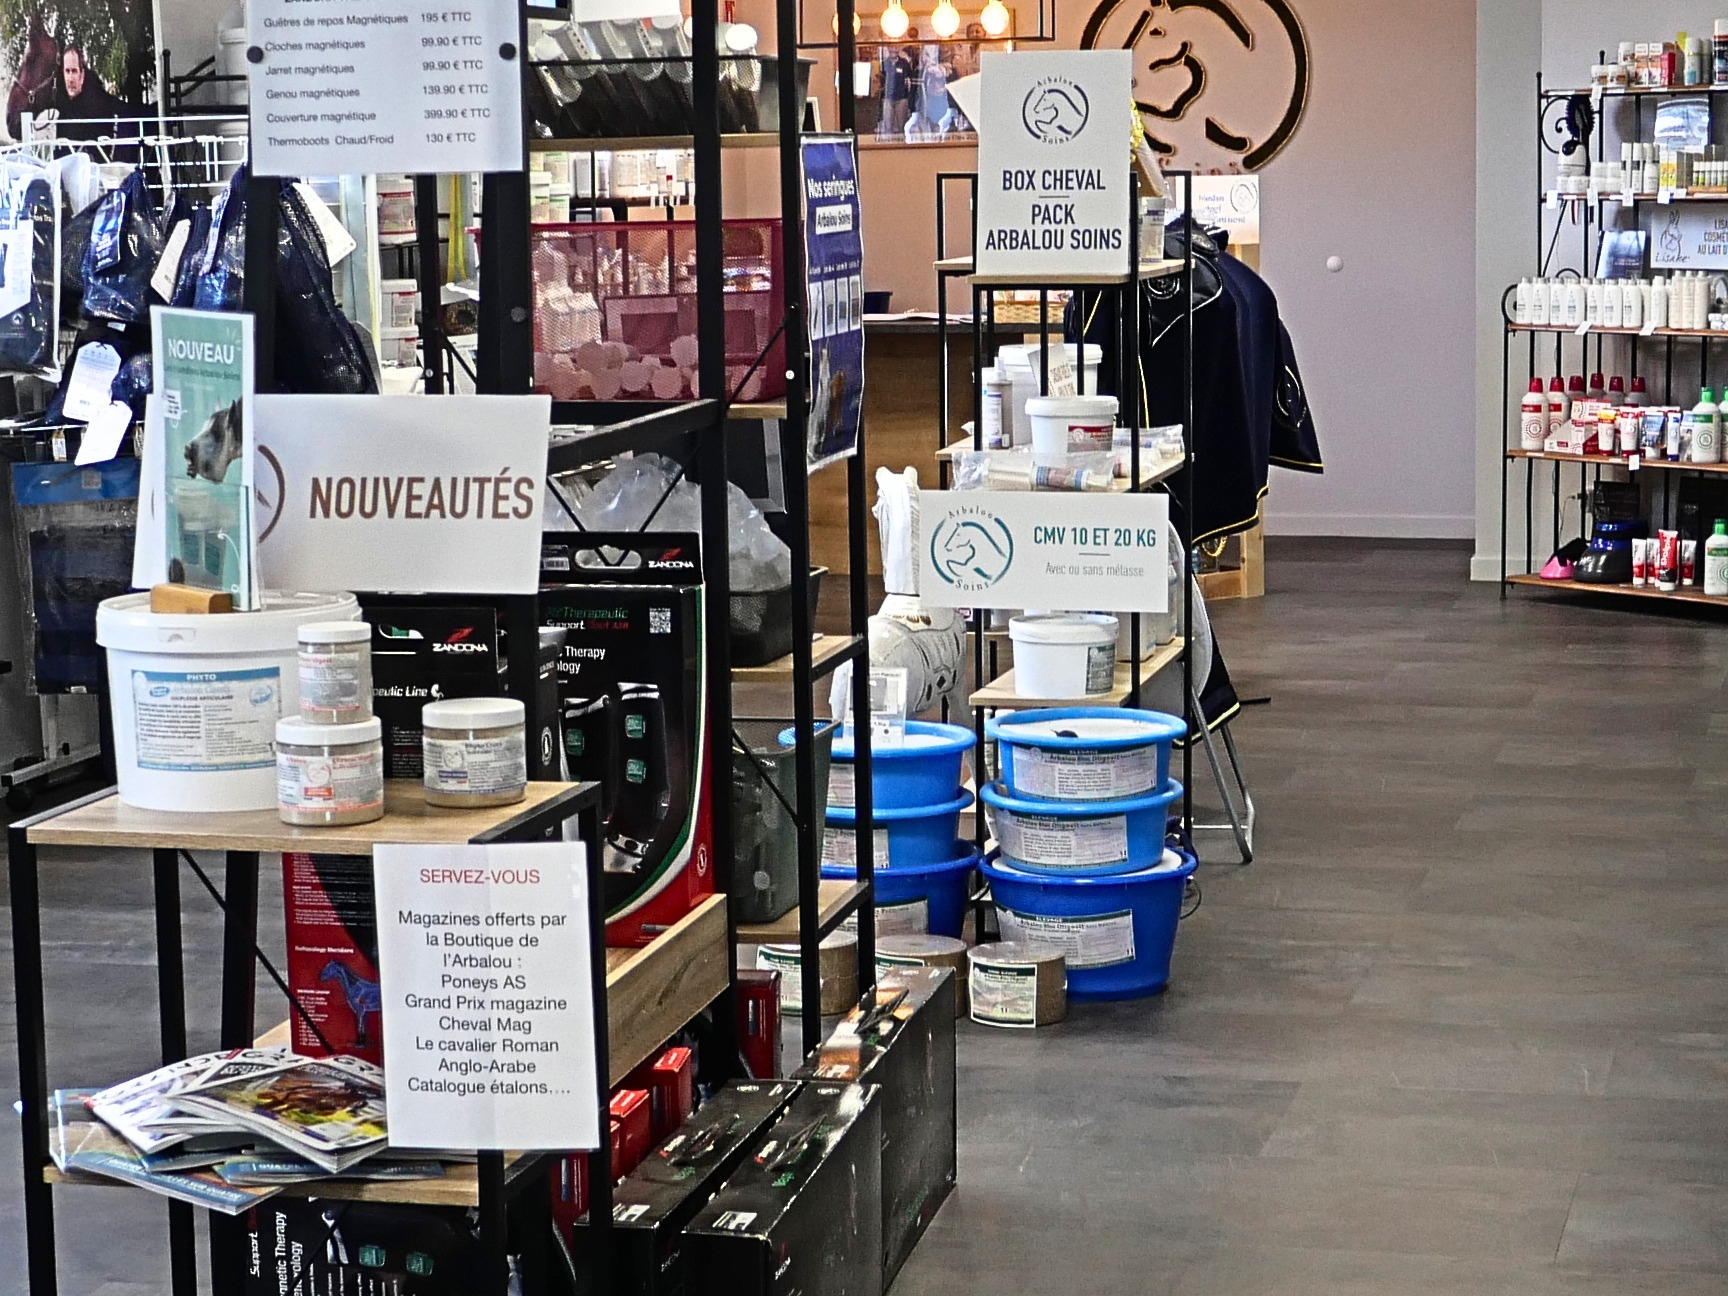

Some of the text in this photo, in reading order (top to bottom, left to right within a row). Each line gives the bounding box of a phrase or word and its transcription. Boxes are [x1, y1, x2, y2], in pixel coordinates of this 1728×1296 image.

[264, 16, 301, 29] Guêtres
[303, 16, 316, 27] de
[317, 18, 345, 29] repos
[346, 14, 409, 27] Magnétiques
[450, 12, 472, 22] TTC
[264, 36, 482, 52] Cloches magnétiques 99.90 TTC
[265, 65, 292, 76] Jarret
[294, 64, 355, 76] magnétiques
[462, 60, 483, 70] TTC
[266, 89, 298, 100] Genou
[299, 88, 360, 101] magnétiques
[468, 84, 488, 94] TTC
[266, 112, 319, 124] Couverture
[321, 111, 377, 124] magnétique
[470, 108, 491, 118] TTC
[267, 133, 476, 147] Thermoboots Chaud/Froid 130 TTC
[1001, 169, 1107, 192] BOX CHEVAL
[1030, 202, 1076, 226] PACK
[985, 228, 1123, 252] ARBALOU SOINS
[167, 337, 235, 365] NOUVEAU
[309, 465, 535, 520] NOUVEAUTÉS
[1034, 526, 1156, 548] CMV 10 ET 20 KG
[648, 560, 694, 569] ZANDONA
[1045, 561, 1145, 577] Avec ou sans mélasse
[432, 642, 489, 653] ZANDONA
[565, 645, 606, 661] Therapy
[186, 673, 217, 681] PHYTO
[405, 686, 428, 698] Line
[419, 868, 541, 885] SERVEZ-VOUS
[398, 910, 567, 929] Magazines offerts par
[426, 932, 539, 950] la Boutique de
[442, 953, 513, 969] l'Arbalou
[441, 974, 527, 992] Poneys AS
[404, 993, 567, 1014] Grand Prix magazine
[438, 1015, 532, 1034] Cheval Mag
[416, 1036, 560, 1053] Le cavalier Roman
[438, 1057, 537, 1076] Anglo-Arabe
[407, 1077, 486, 1096] Catalogue
[275, 1211, 287, 1257] Therapy
[248, 1230, 260, 1278] Support
